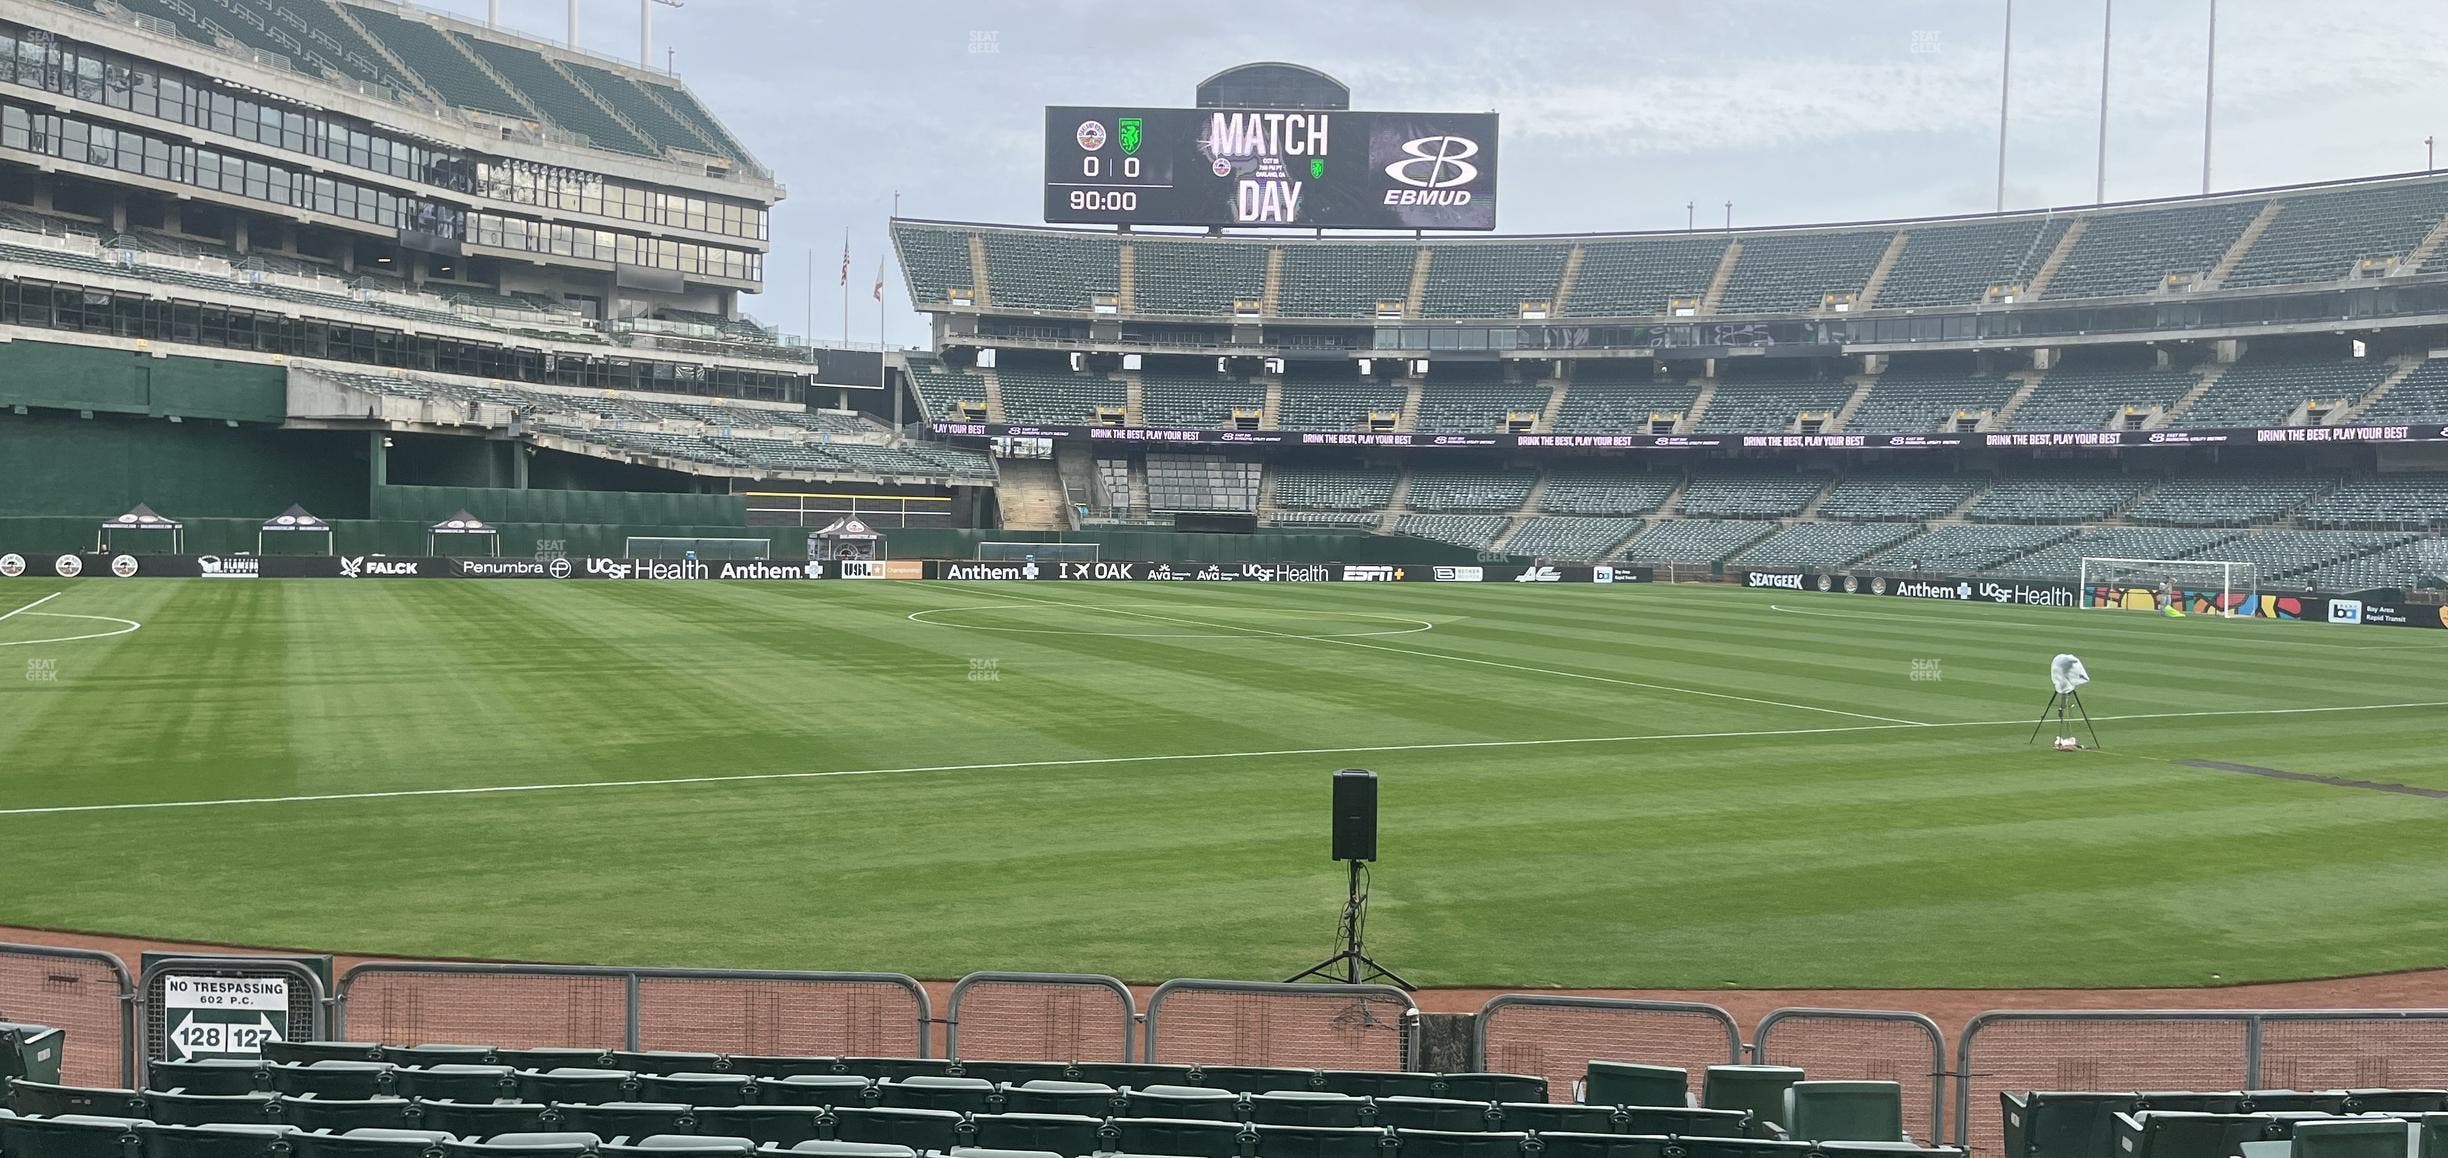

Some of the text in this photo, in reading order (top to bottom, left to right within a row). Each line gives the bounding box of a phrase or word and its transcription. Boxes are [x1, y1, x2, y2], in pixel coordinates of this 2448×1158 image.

[1212, 112, 1328, 156] MATCH
[1083, 156, 1140, 178] 0 0
[1070, 190, 1137, 210] 90:00
[1240, 180, 1302, 222] DAY
[1384, 190, 1471, 206] EBMUD
[949, 424, 967, 434] YOUR
[968, 425, 985, 435] BEST
[1091, 428, 1111, 438] DRINK
[1112, 429, 1126, 439] THE
[1146, 430, 1162, 440] PLAY
[1164, 430, 1182, 440] YOUR
[1182, 431, 1200, 441] BEST
[2258, 430, 2286, 442] DRINK
[2288, 430, 2304, 441] THE
[2333, 428, 2354, 440] PLAY
[2357, 428, 2382, 439] YOUR
[2384, 427, 2408, 438] BEST
[1303, 434, 1322, 444] DRINK
[1324, 434, 1338, 444] THE
[1358, 434, 1374, 444] PLAY
[1376, 434, 1394, 444] YOUR
[1395, 435, 1412, 444] BEST
[1518, 436, 1540, 446] DRINK
[1540, 436, 1554, 446] THE
[1575, 436, 1592, 446] PLAY
[1592, 436, 1612, 446] YOUR
[1614, 436, 1632, 446] BEST
[1744, 436, 1766, 446] DRINK
[1768, 436, 1782, 446] THE
[1804, 436, 1822, 446] PLAY
[1824, 436, 1844, 446] YOUR
[1846, 436, 1864, 446] BEST
[1986, 435, 2011, 445] DRINK
[2013, 435, 2028, 445] THE
[2054, 434, 2074, 444] PLAY
[2075, 434, 2098, 444] YOUR
[2099, 434, 2120, 444] BEST
[366, 562, 418, 574] FALCK
[464, 562, 544, 574] Penumbra
[587, 558, 708, 580] UCSF Health
[1095, 564, 1134, 578] OAK
[1243, 564, 1274, 582] UCSF
[1277, 565, 1328, 582] Health
[1148, 570, 1170, 580] Ava
[1196, 570, 1220, 580] Ava
[1750, 572, 1803, 590] SEATGEEK
[1980, 582, 2073, 606] UCSF Health
[2366, 614, 2384, 622] Rapid
[170, 981, 283, 994] NO TRESPASSING
[200, 996, 223, 1004] 602
[180, 1028, 220, 1046] 128
[234, 1029, 272, 1047] 127
